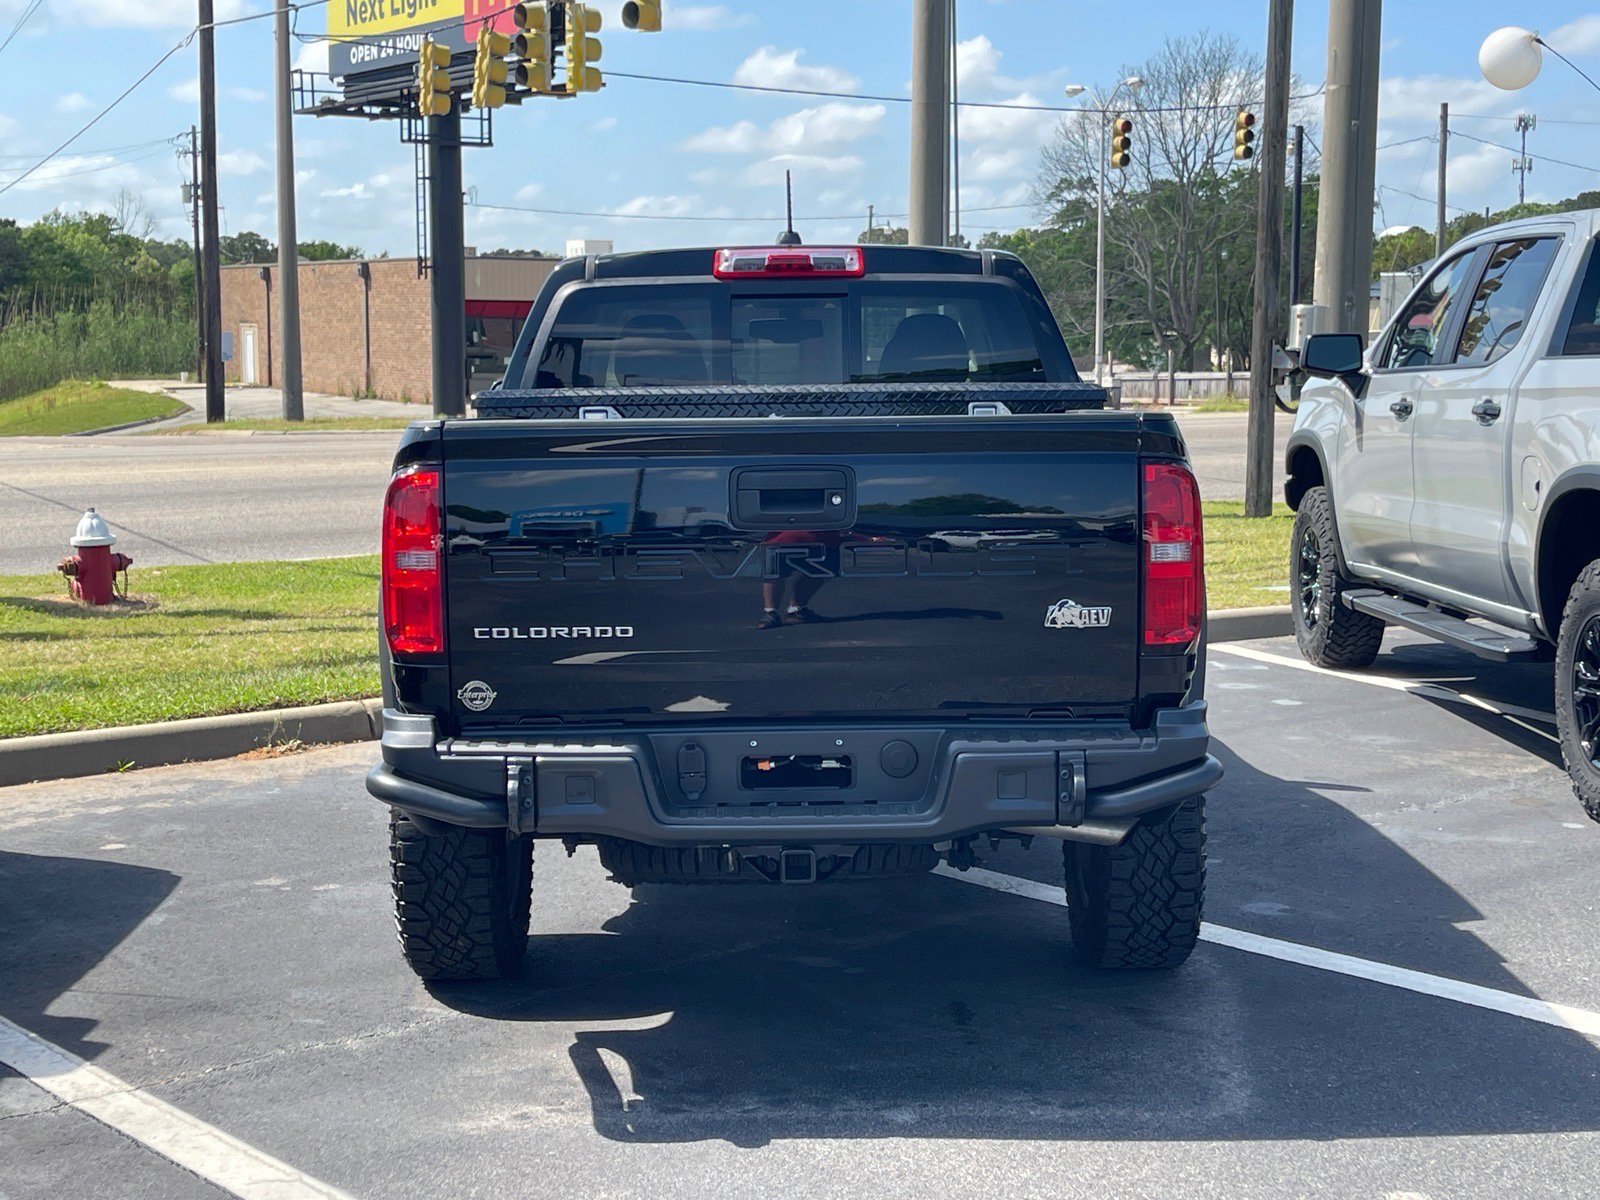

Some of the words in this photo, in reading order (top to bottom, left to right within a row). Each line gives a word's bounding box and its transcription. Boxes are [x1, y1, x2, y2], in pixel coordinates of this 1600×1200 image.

[346, 0, 385, 27] Next
[391, 0, 437, 19] Lig
[350, 42, 378, 65] OPEN
[380, 38, 394, 58] 24
[481, 542, 1107, 581] CHEVROLET
[1081, 609, 1109, 625] AEV
[473, 626, 634, 639] COLORADO
